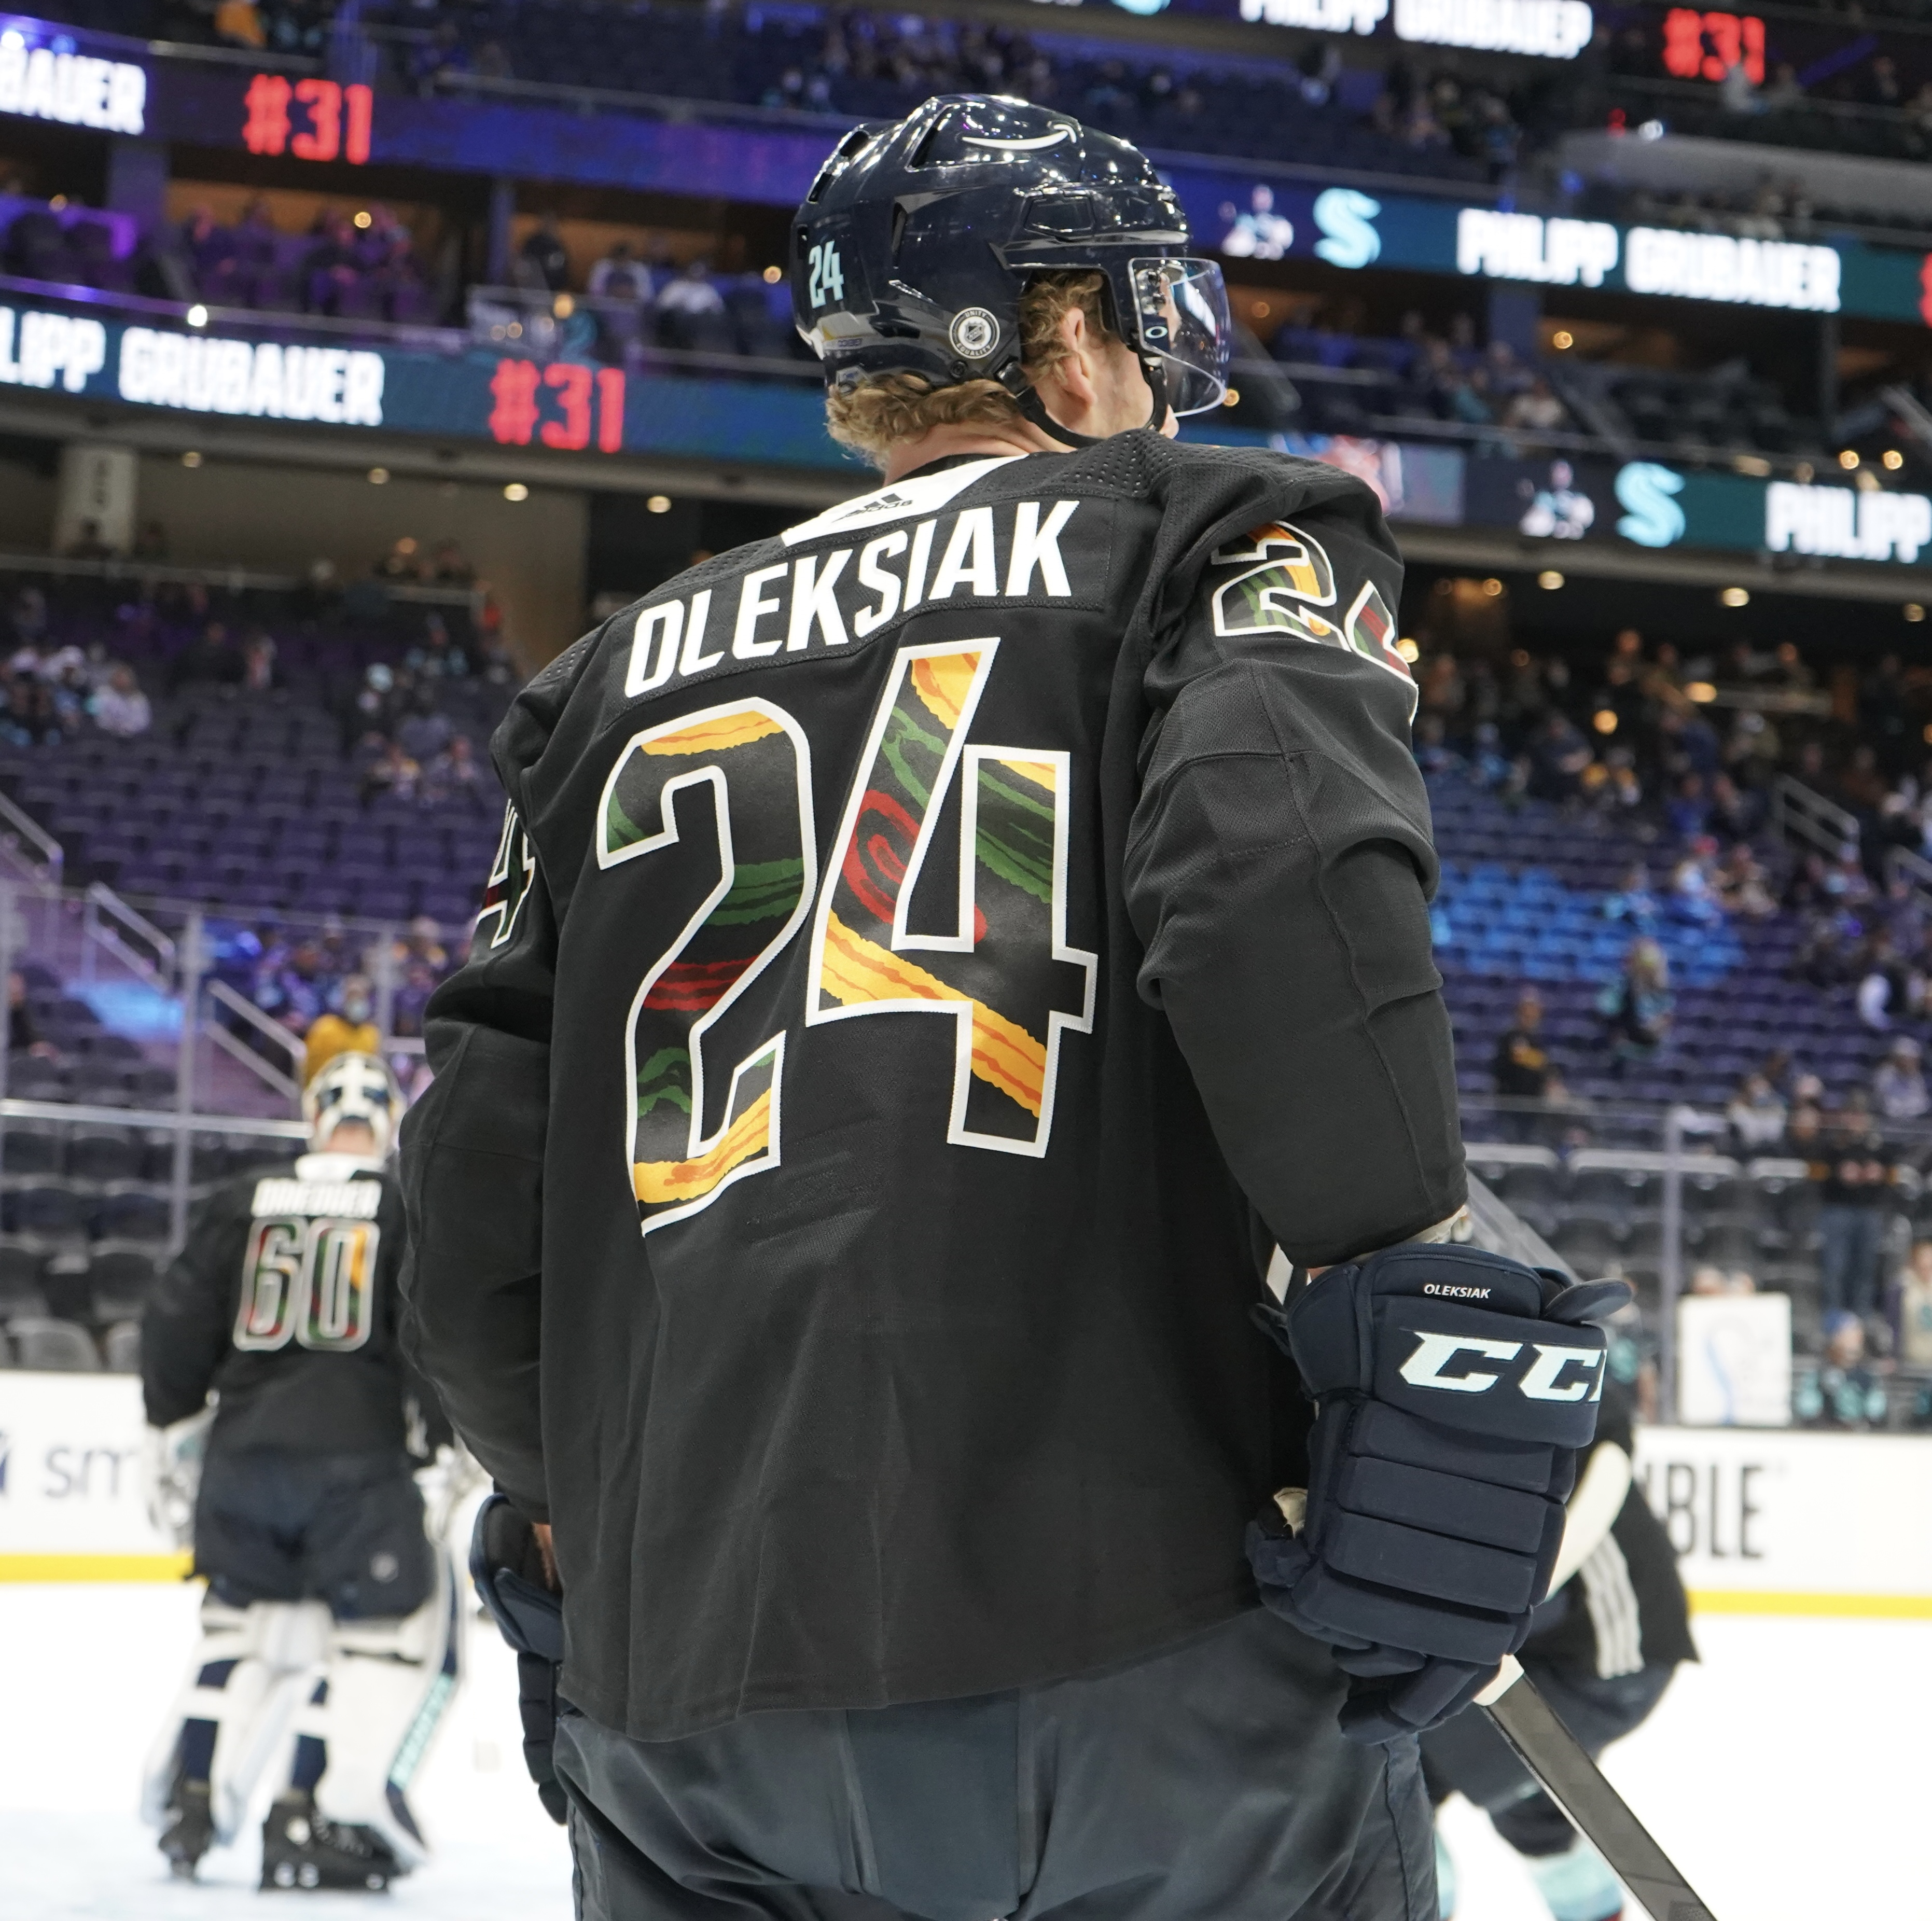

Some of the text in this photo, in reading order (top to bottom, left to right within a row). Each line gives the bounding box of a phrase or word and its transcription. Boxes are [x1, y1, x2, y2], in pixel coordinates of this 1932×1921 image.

[243, 74, 372, 165] #31
[809, 240, 844, 308] 24
[1457, 208, 1618, 287] PHILIPP
[119, 327, 385, 426] GRUBAUER
[956, 342, 991, 356] EQUALITY
[490, 358, 626, 453] #31
[1766, 481, 1932, 563] PHILIPP
[624, 500, 1080, 698] OLEKSIAK
[597, 636, 1099, 1237] 24
[233, 1216, 380, 1352] 60
[1424, 1284, 1492, 1299] OLEKSIAK
[1400, 1331, 1607, 1402] CC
[1641, 1463, 1766, 1560] BLE
